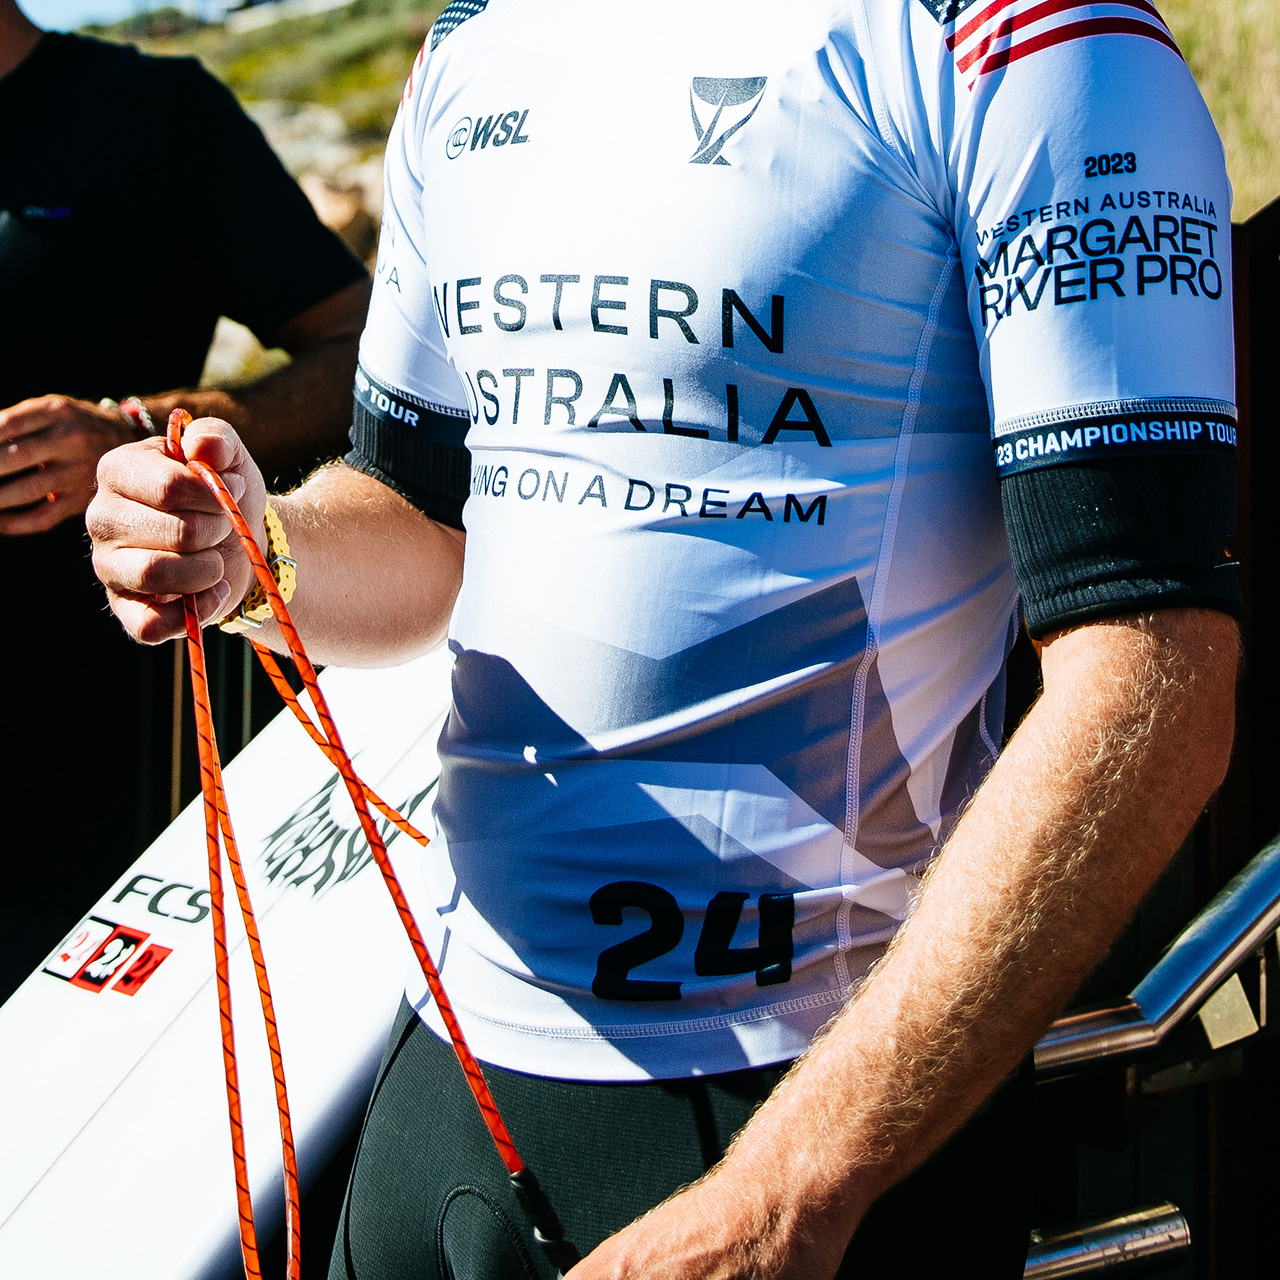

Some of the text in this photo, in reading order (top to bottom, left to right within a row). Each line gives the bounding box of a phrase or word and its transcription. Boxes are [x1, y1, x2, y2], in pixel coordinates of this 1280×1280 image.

[470, 109, 530, 151] WSL
[1084, 151, 1137, 178] 2023
[976, 190, 1217, 246] WESTERN AUSTRALIA
[975, 214, 1218, 285] MARGARET
[979, 254, 1222, 326] RIVER PRO
[370, 388, 420, 428] TOUR
[459, 367, 832, 448] USTRALIA
[1015, 420, 1203, 460] CHAMPIONSHIP
[517, 468, 569, 503] ON
[578, 474, 608, 508] A
[624, 478, 828, 526] DREAM
[111, 874, 212, 924] FCS
[588, 880, 796, 1001] 24
